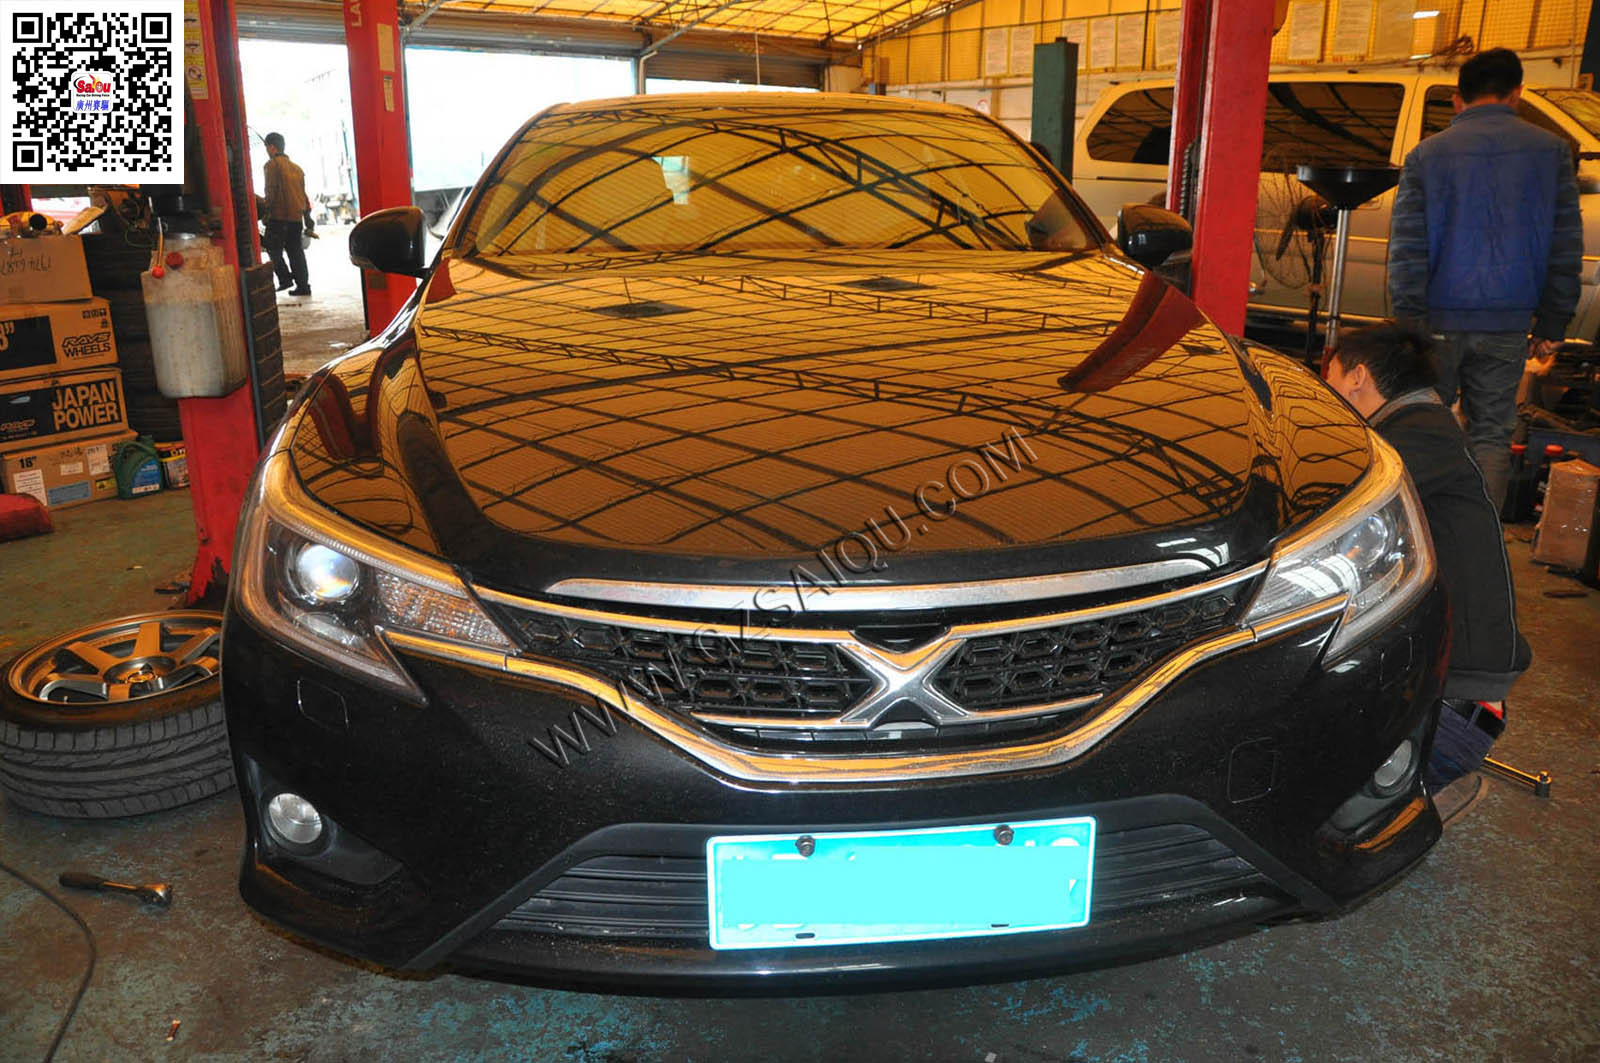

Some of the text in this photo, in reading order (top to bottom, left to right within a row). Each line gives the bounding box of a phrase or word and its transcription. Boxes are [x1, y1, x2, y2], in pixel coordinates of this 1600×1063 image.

[64, 342, 112, 359] WHEELS
[51, 381, 116, 410] JAPAN
[53, 402, 119, 431] POWER
